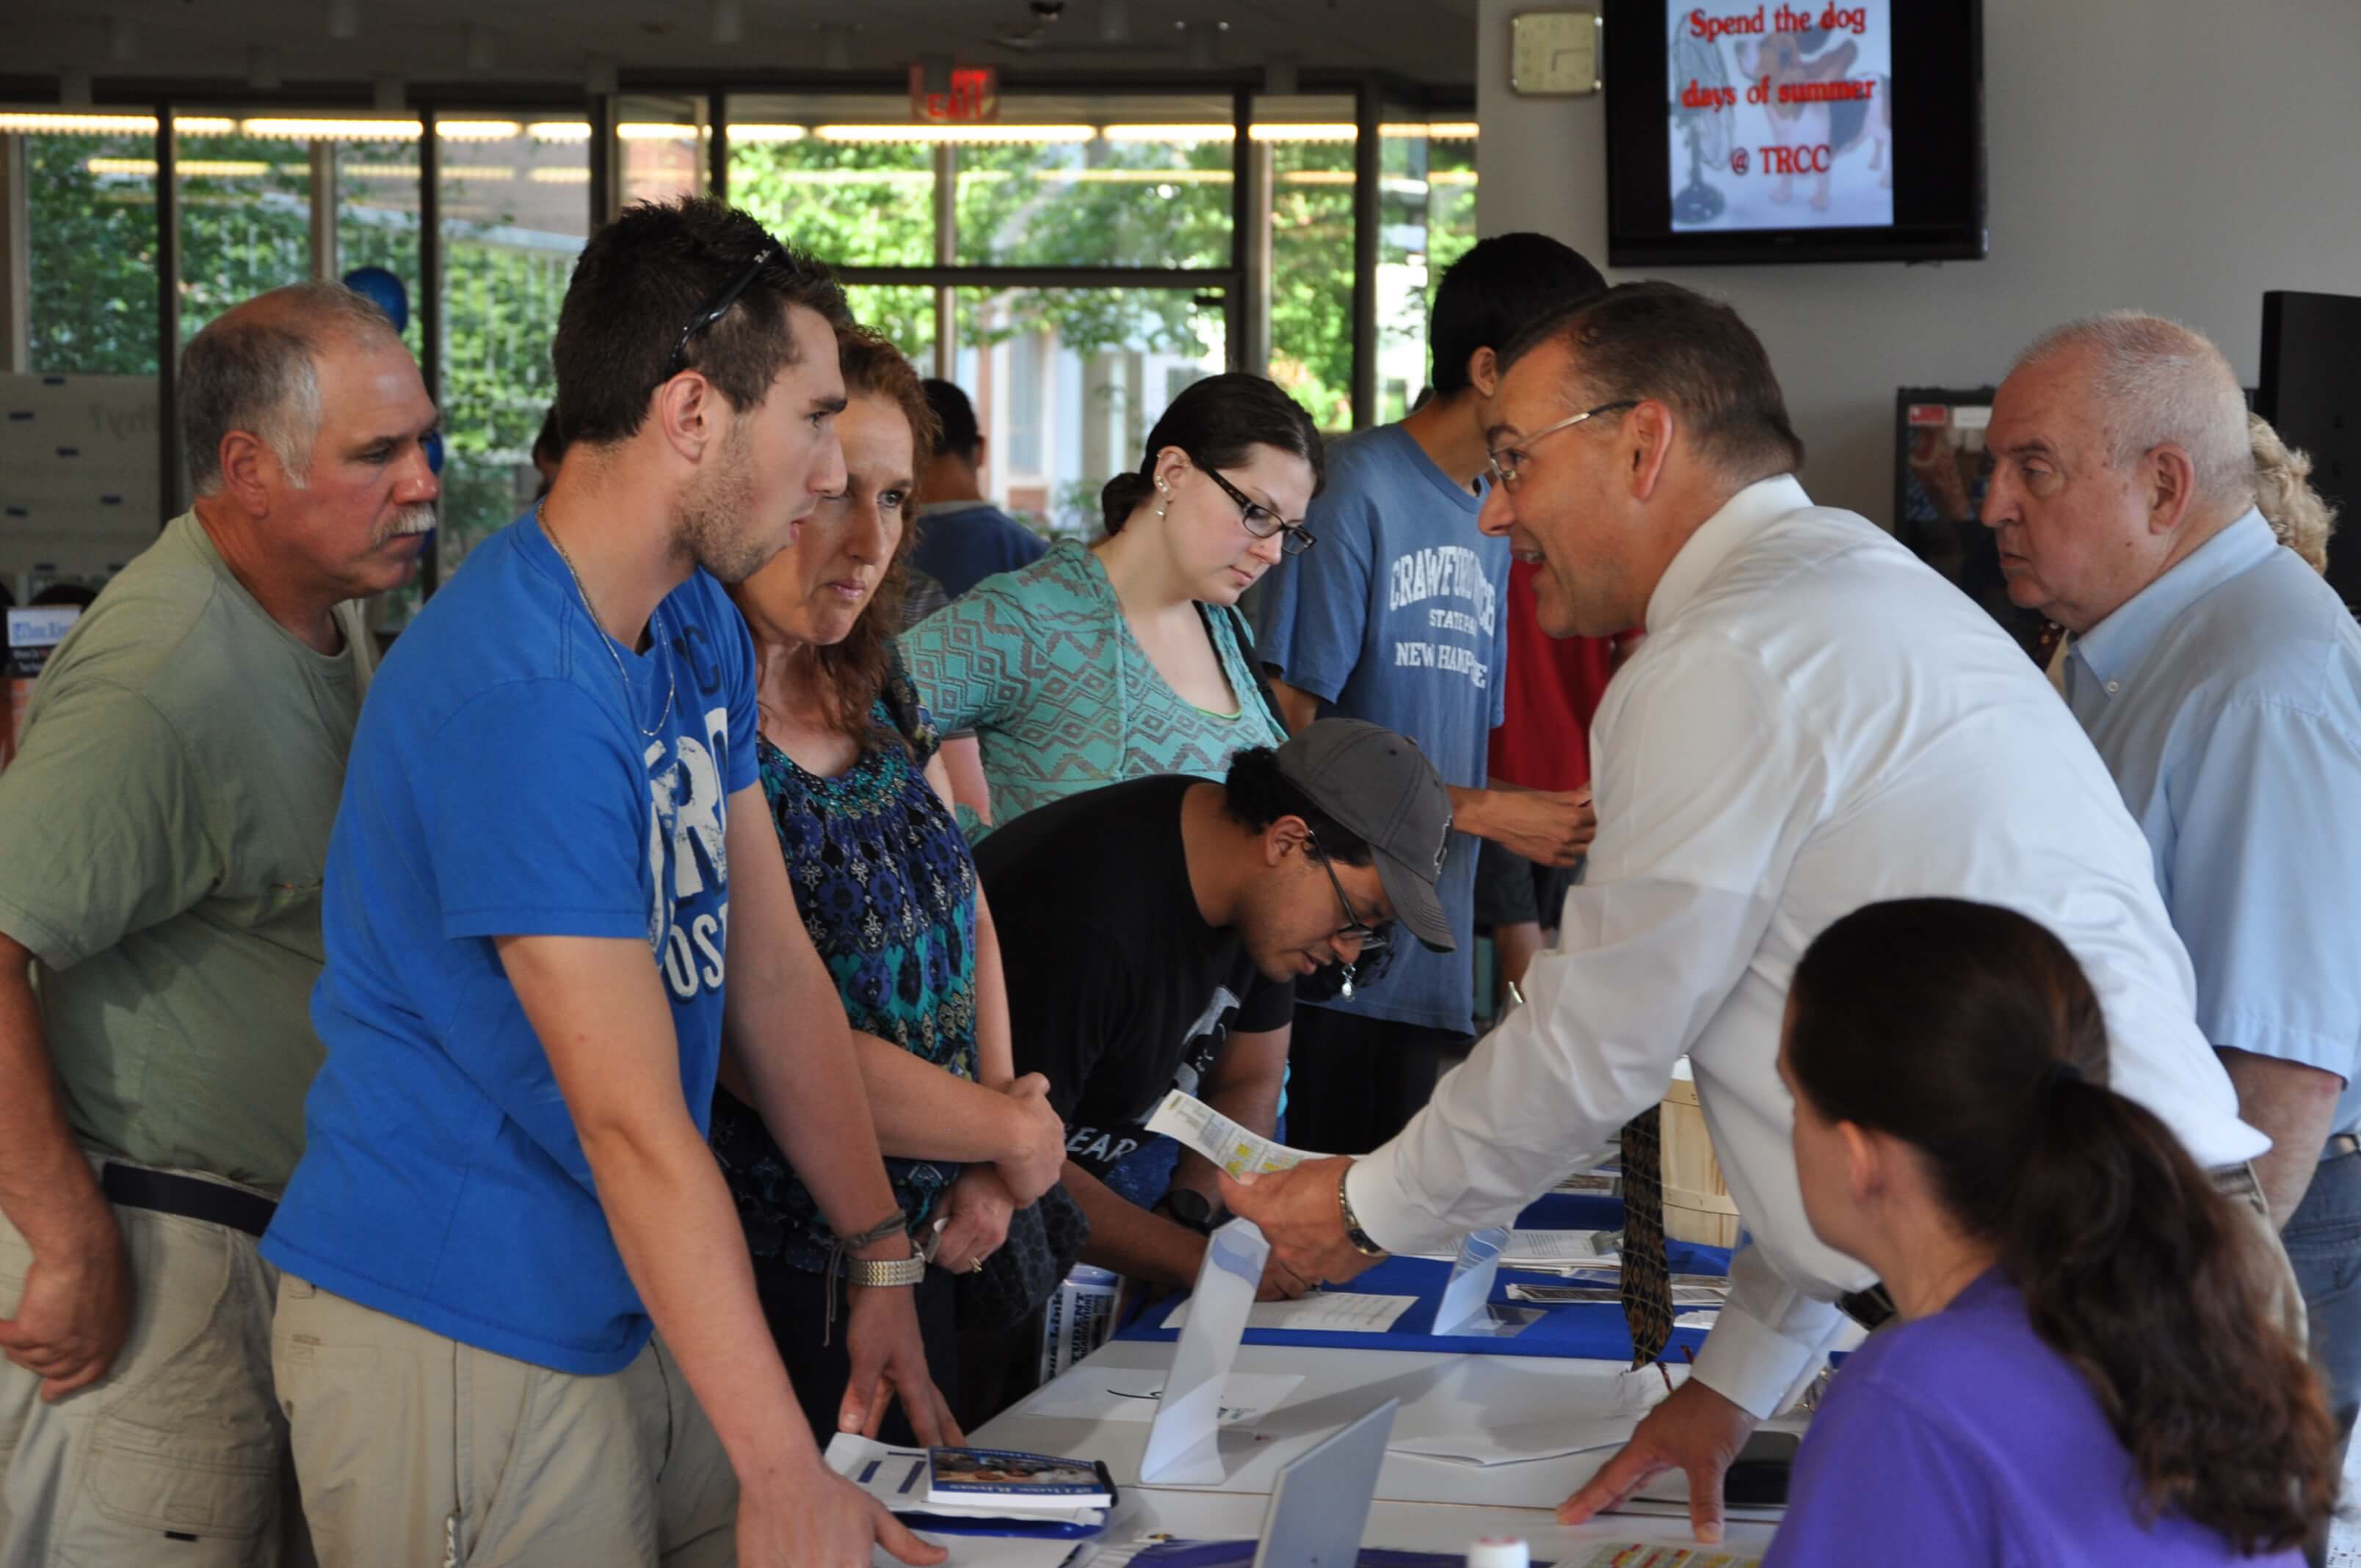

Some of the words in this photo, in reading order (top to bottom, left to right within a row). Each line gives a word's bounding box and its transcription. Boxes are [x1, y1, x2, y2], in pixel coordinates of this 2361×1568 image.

[1689, 4, 1765, 43] Spend
[1774, 3, 1810, 33] the
[1819, 1, 1865, 35] dog
[1681, 79, 1736, 113] days
[1747, 73, 1770, 104] of
[1778, 80, 1876, 104] summer
[1730, 148, 1749, 175] @
[1759, 145, 1831, 175] TRCC
[1395, 642, 1435, 667] NEW
[1065, 1126, 1138, 1162] EAR
[1071, 1291, 1085, 1365] TUDENT
